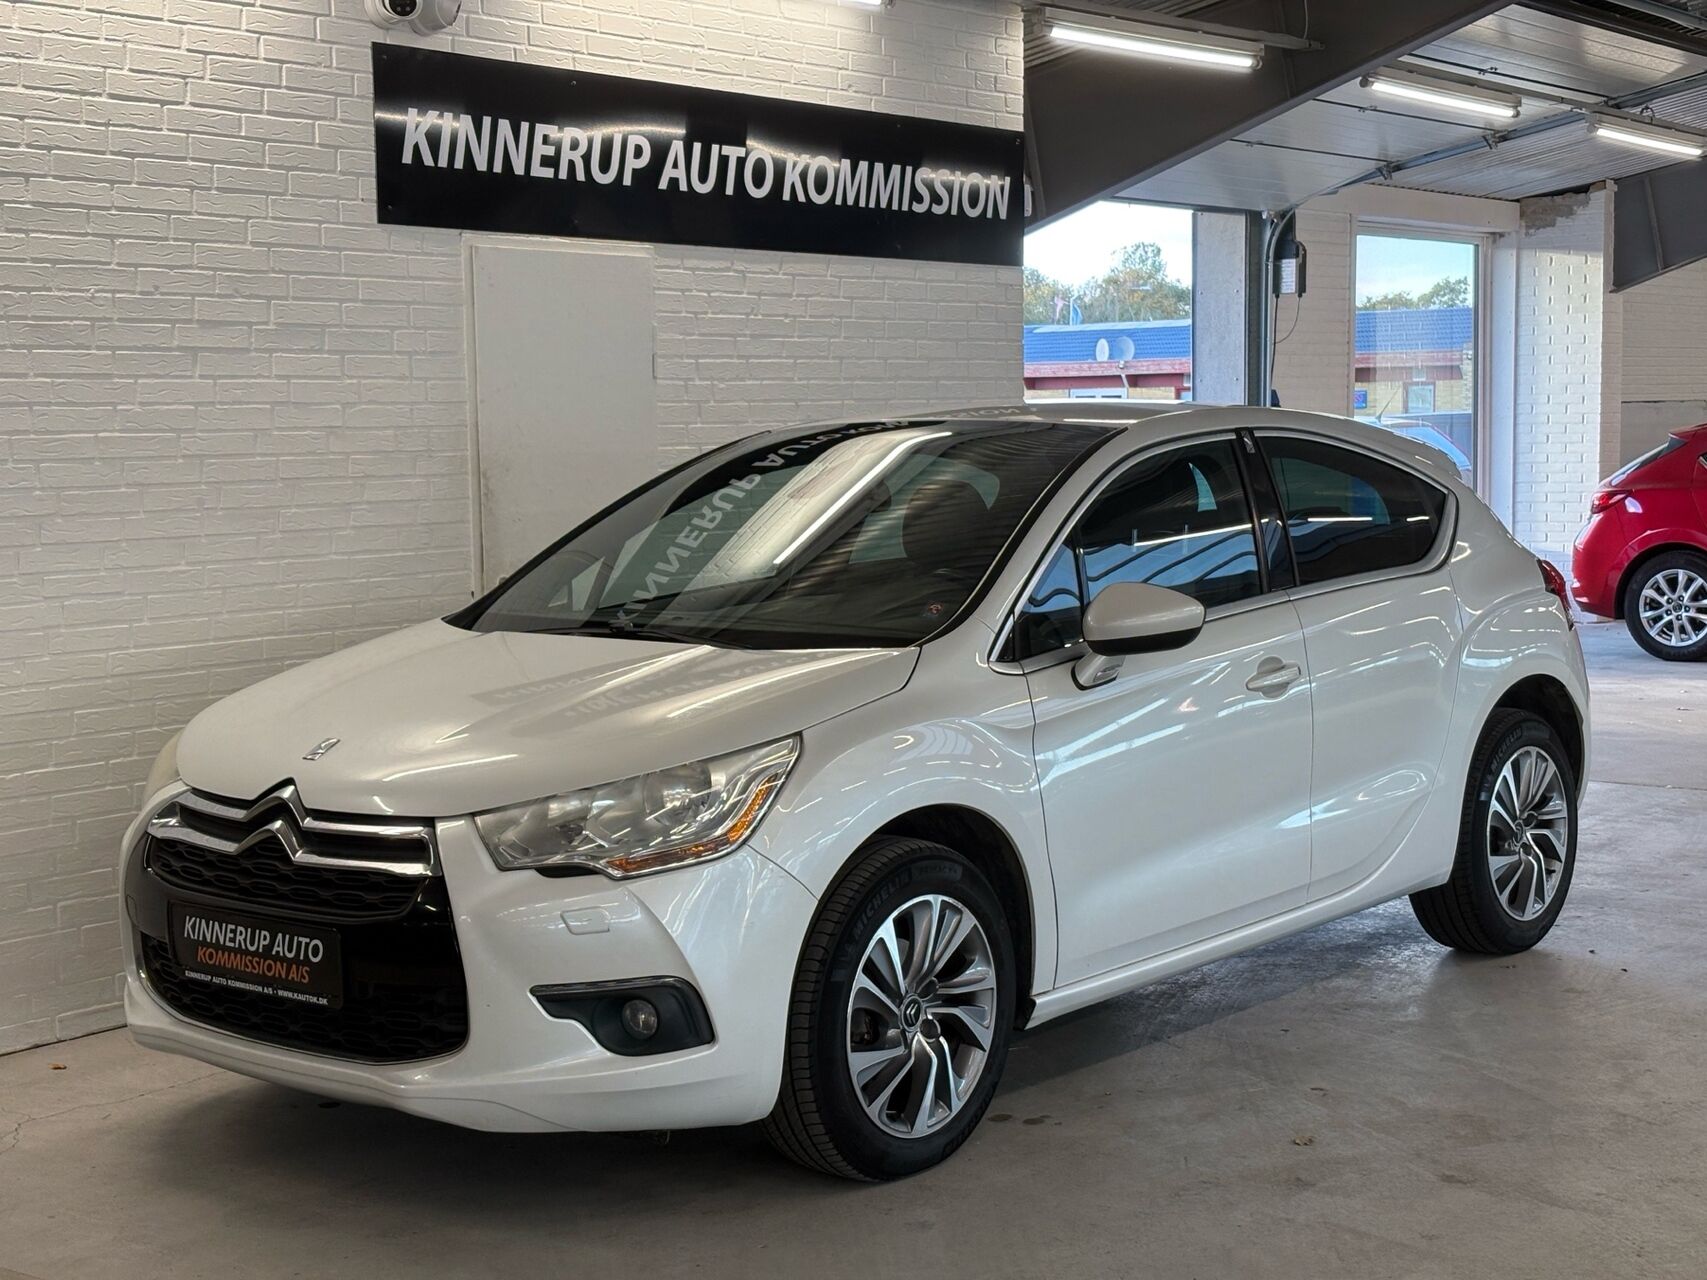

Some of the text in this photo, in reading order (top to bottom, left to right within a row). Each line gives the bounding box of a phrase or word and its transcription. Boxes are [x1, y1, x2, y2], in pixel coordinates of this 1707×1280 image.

[400, 107, 1011, 221] KINNERUP AUTO KOMMISSION
[852, 870, 911, 940] MICHELIN
[184, 916, 323, 963] KINNERUP AUTO
[196, 946, 287, 979] KOMMISSION
[185, 970, 212, 982] KINNERUP
[212, 976, 227, 986] AUTO
[228, 979, 263, 993] KOMMISSION
[264, 985, 273, 995] A/S
